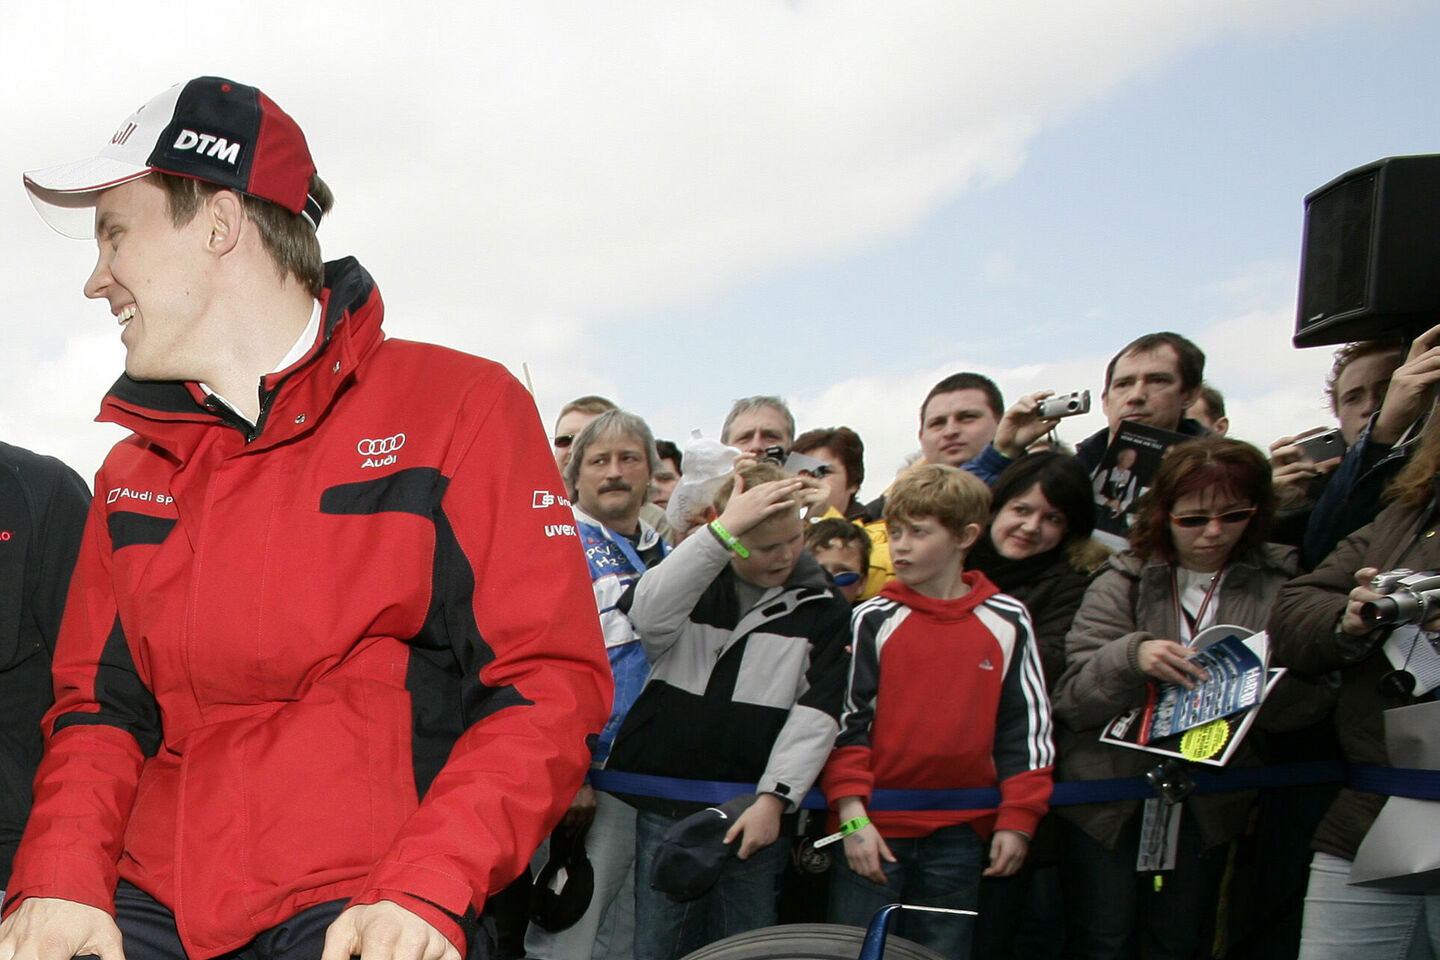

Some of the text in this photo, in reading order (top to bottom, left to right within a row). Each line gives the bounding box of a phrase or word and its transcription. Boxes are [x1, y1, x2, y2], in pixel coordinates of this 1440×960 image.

[107, 122, 138, 145] ull
[173, 129, 242, 165] DTM
[361, 455, 398, 469] Audi
[120, 487, 153, 502] Audi
[544, 524, 578, 538] uvex
